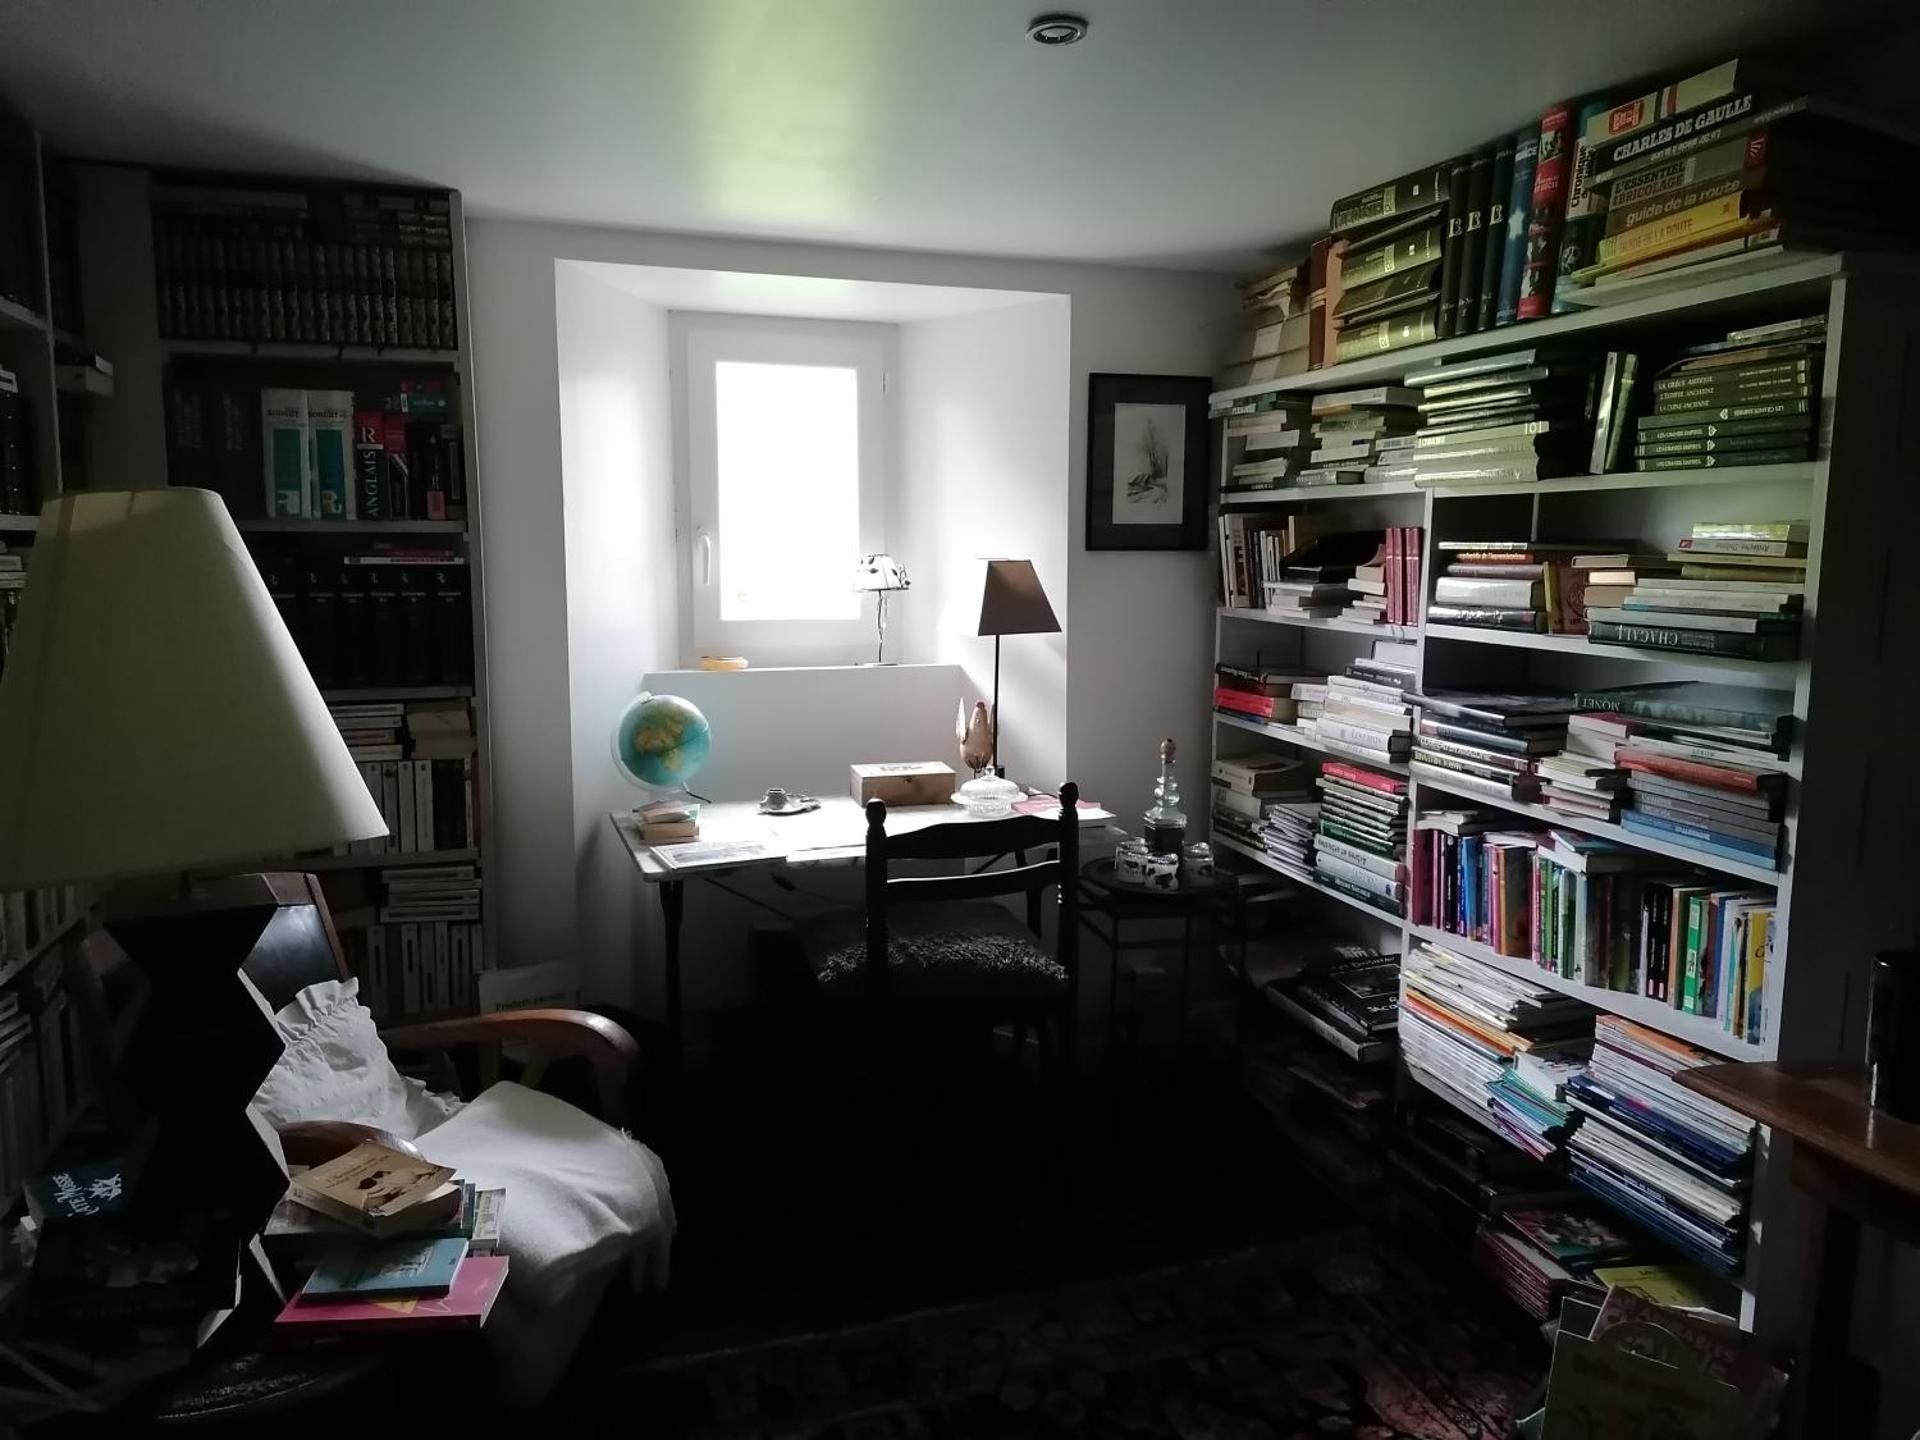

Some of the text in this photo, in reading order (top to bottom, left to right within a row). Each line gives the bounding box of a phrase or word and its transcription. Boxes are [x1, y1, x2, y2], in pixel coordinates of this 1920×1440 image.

[1613, 126, 1673, 162] CHARLES
[1674, 121, 1693, 140] DE
[1694, 94, 1752, 130] GAULLE
[1615, 162, 1685, 193] L'ESSENTIEL
[1626, 180, 1741, 227] guide de la route
[362, 449, 380, 519] ANGLAIS
[1615, 624, 1678, 647] CHAGALL
[1581, 697, 1621, 713] MONET
